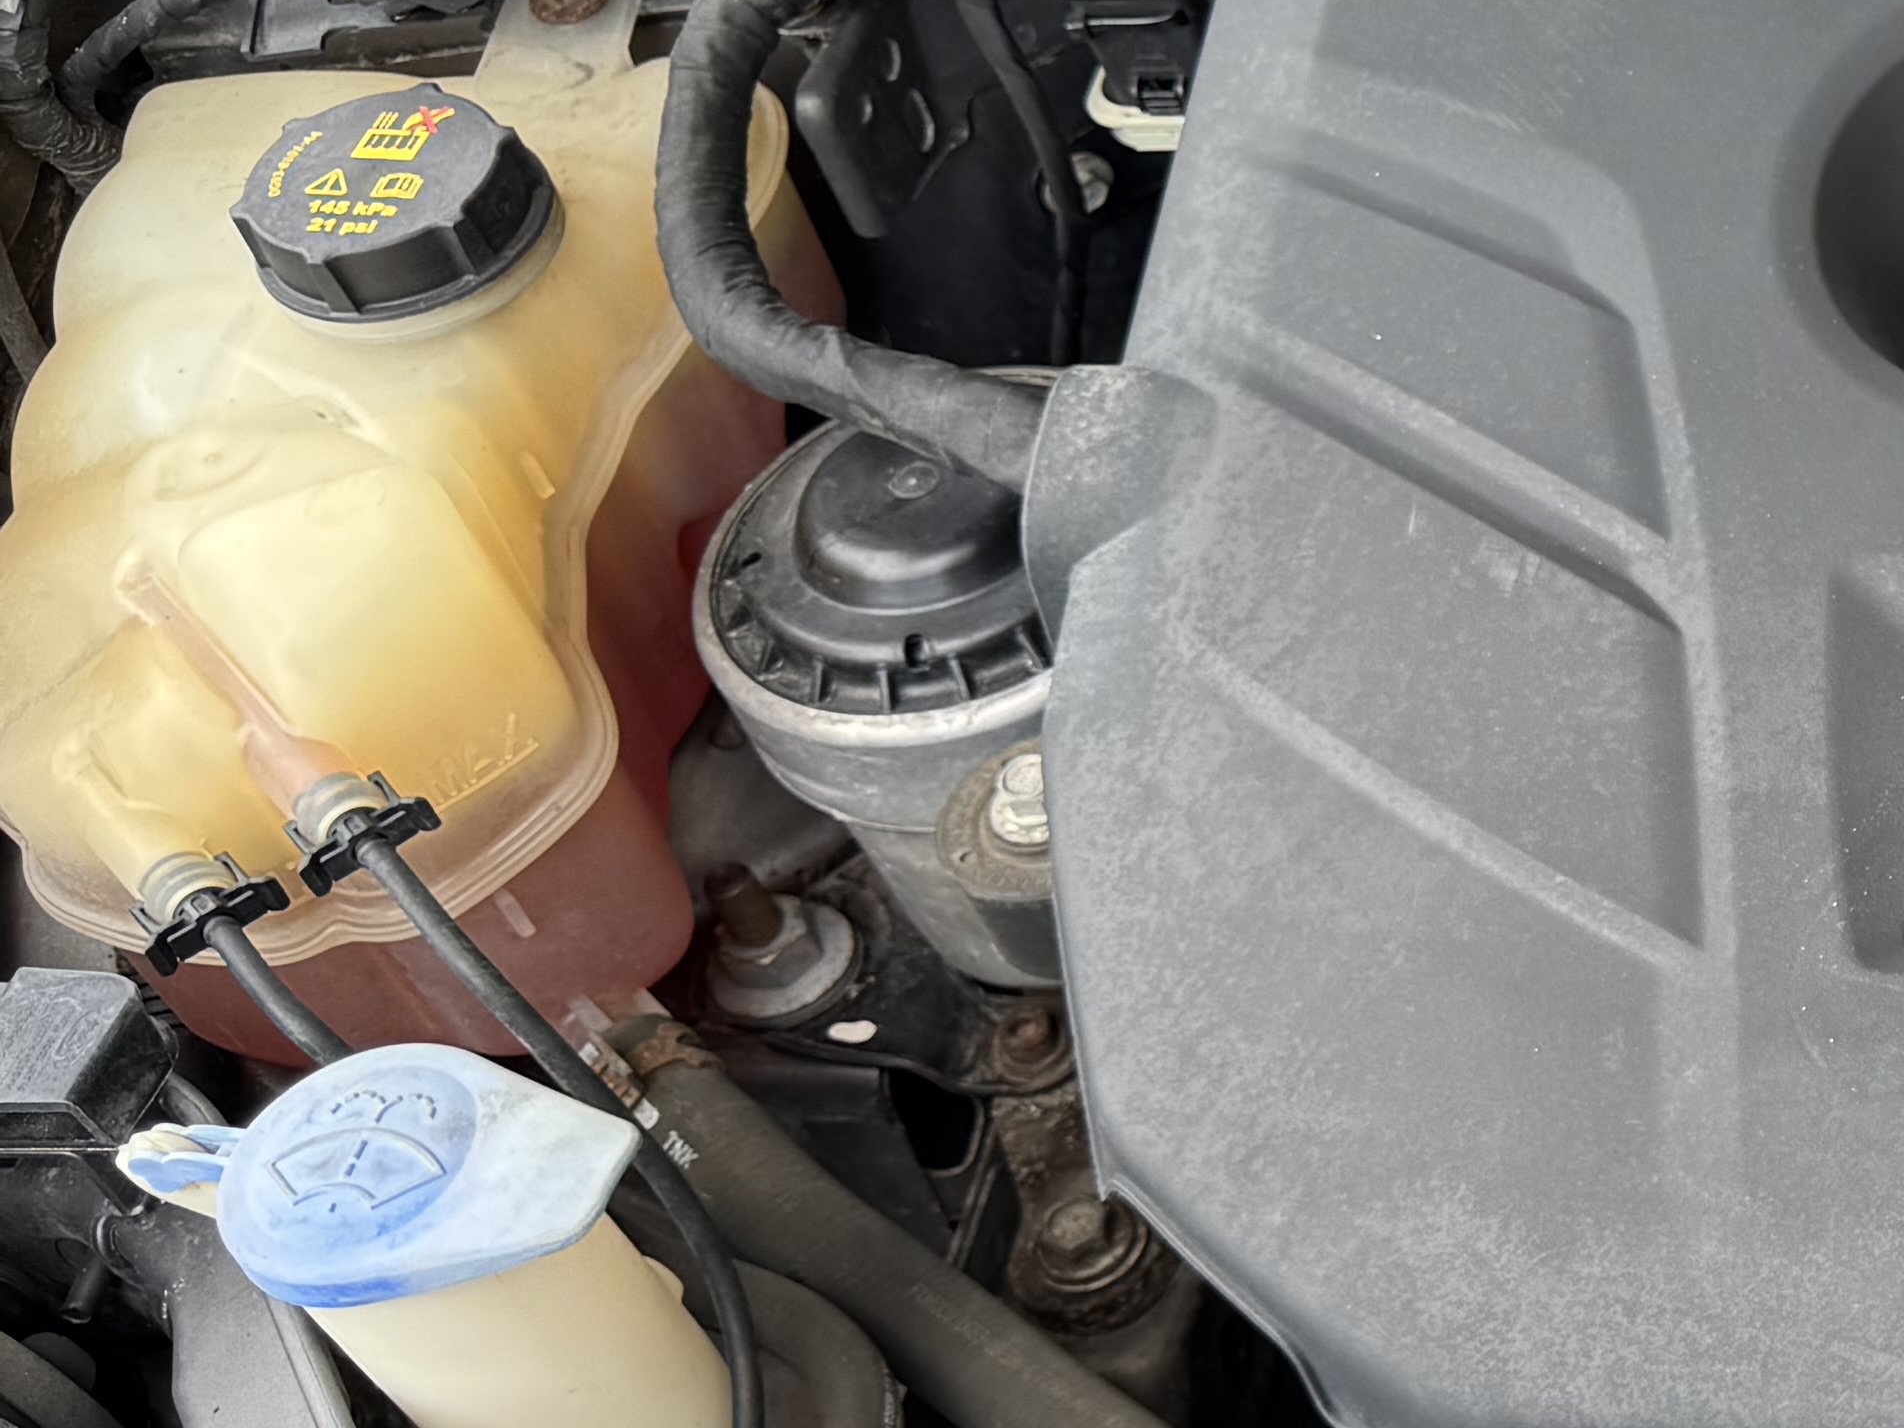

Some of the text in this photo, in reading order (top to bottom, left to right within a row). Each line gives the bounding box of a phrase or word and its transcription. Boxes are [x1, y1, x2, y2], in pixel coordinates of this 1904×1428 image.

[308, 200, 398, 217] 145 kPa
[306, 218, 379, 236] 21 psi
[659, 1129, 698, 1167] TNK
